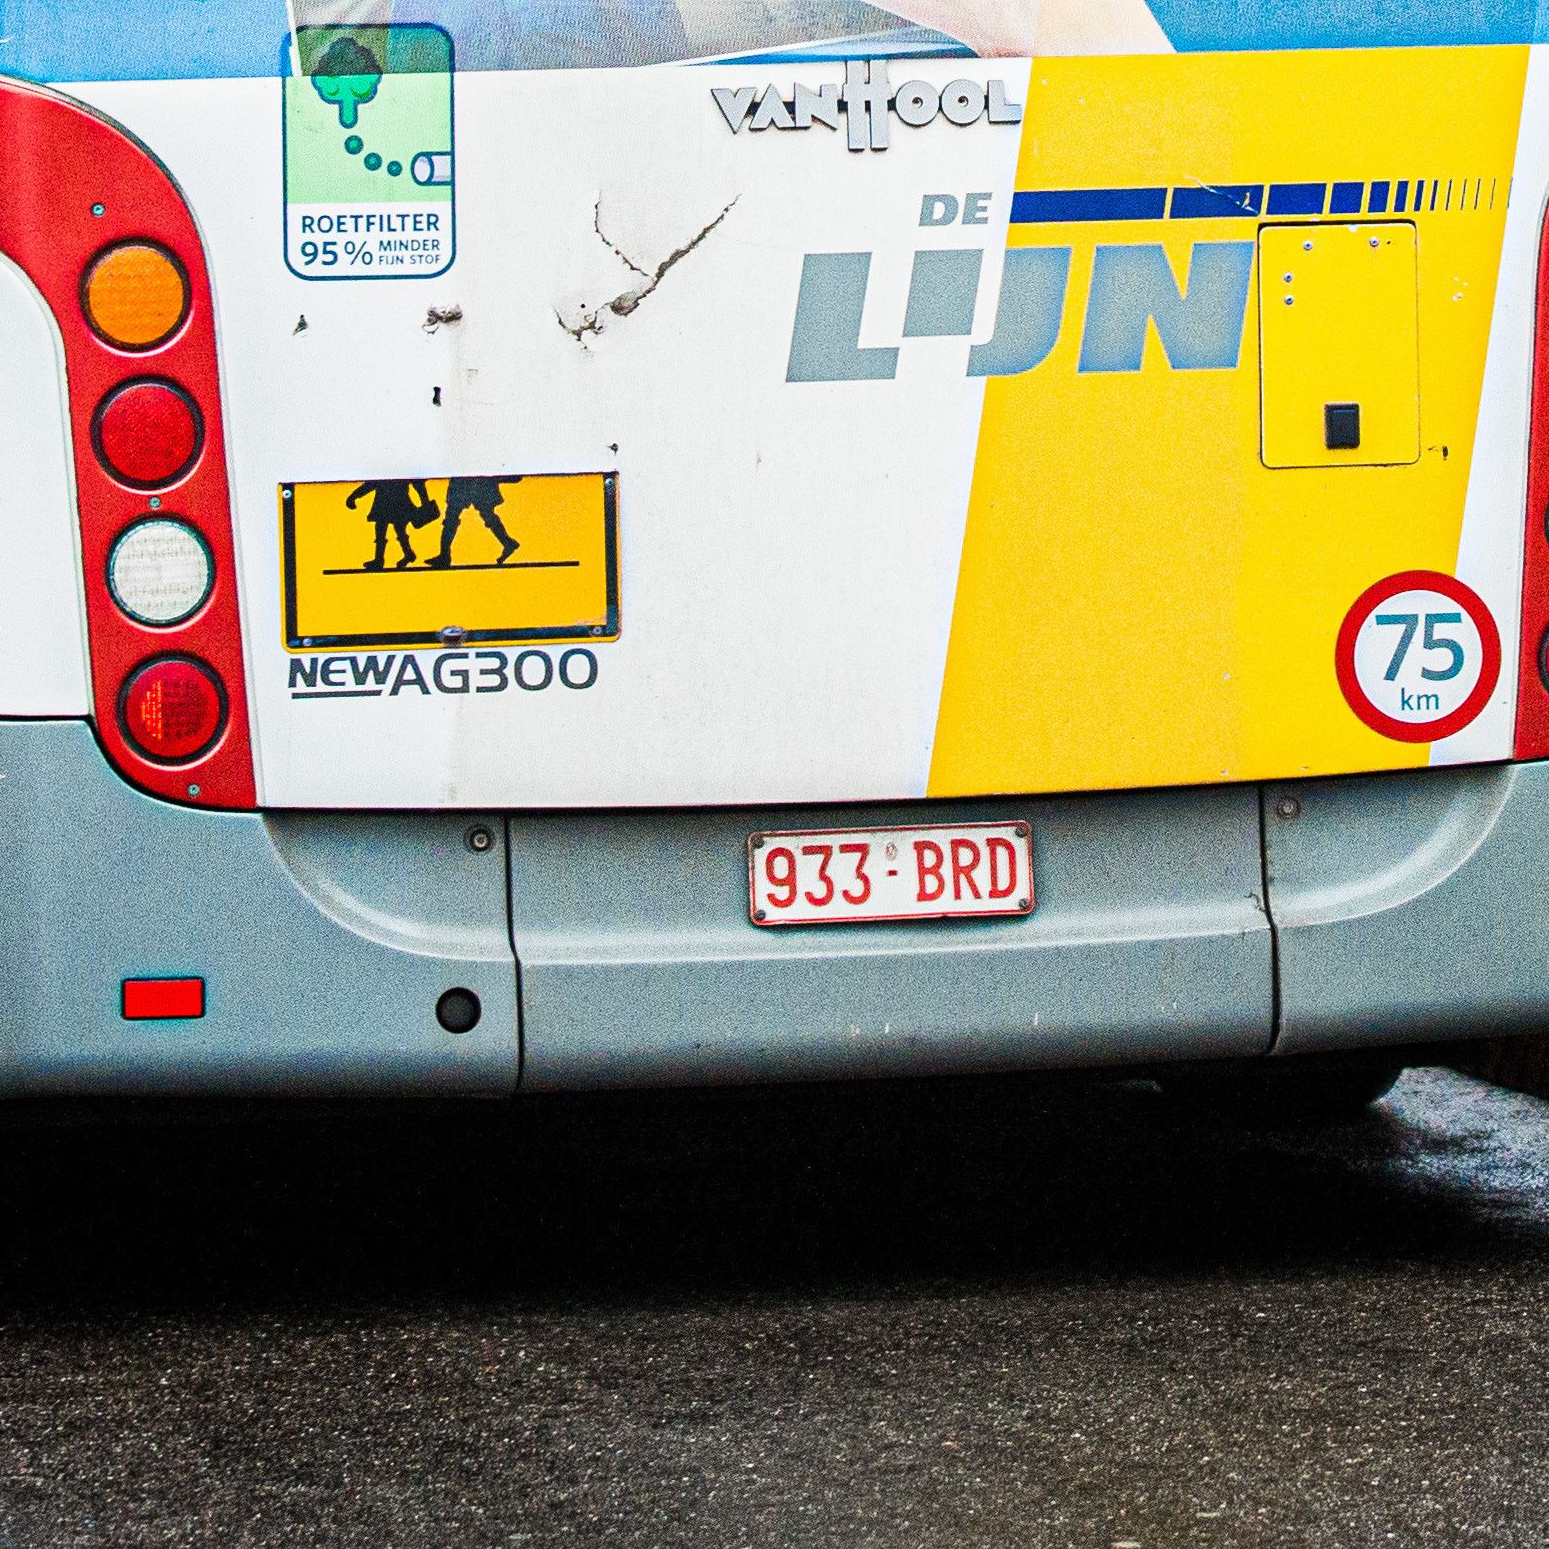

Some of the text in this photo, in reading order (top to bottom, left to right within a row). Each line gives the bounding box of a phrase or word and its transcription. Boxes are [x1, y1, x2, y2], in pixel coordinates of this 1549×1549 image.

[301, 213, 440, 234] ROETFILTER
[918, 192, 993, 227] DE
[378, 239, 441, 252] MINDER
[378, 254, 441, 266] FIJN STOF
[786, 241, 1257, 383] LIJN
[1374, 611, 1465, 682] 75
[1400, 686, 1440, 712] km
[765, 837, 1018, 909] 933-BRD
